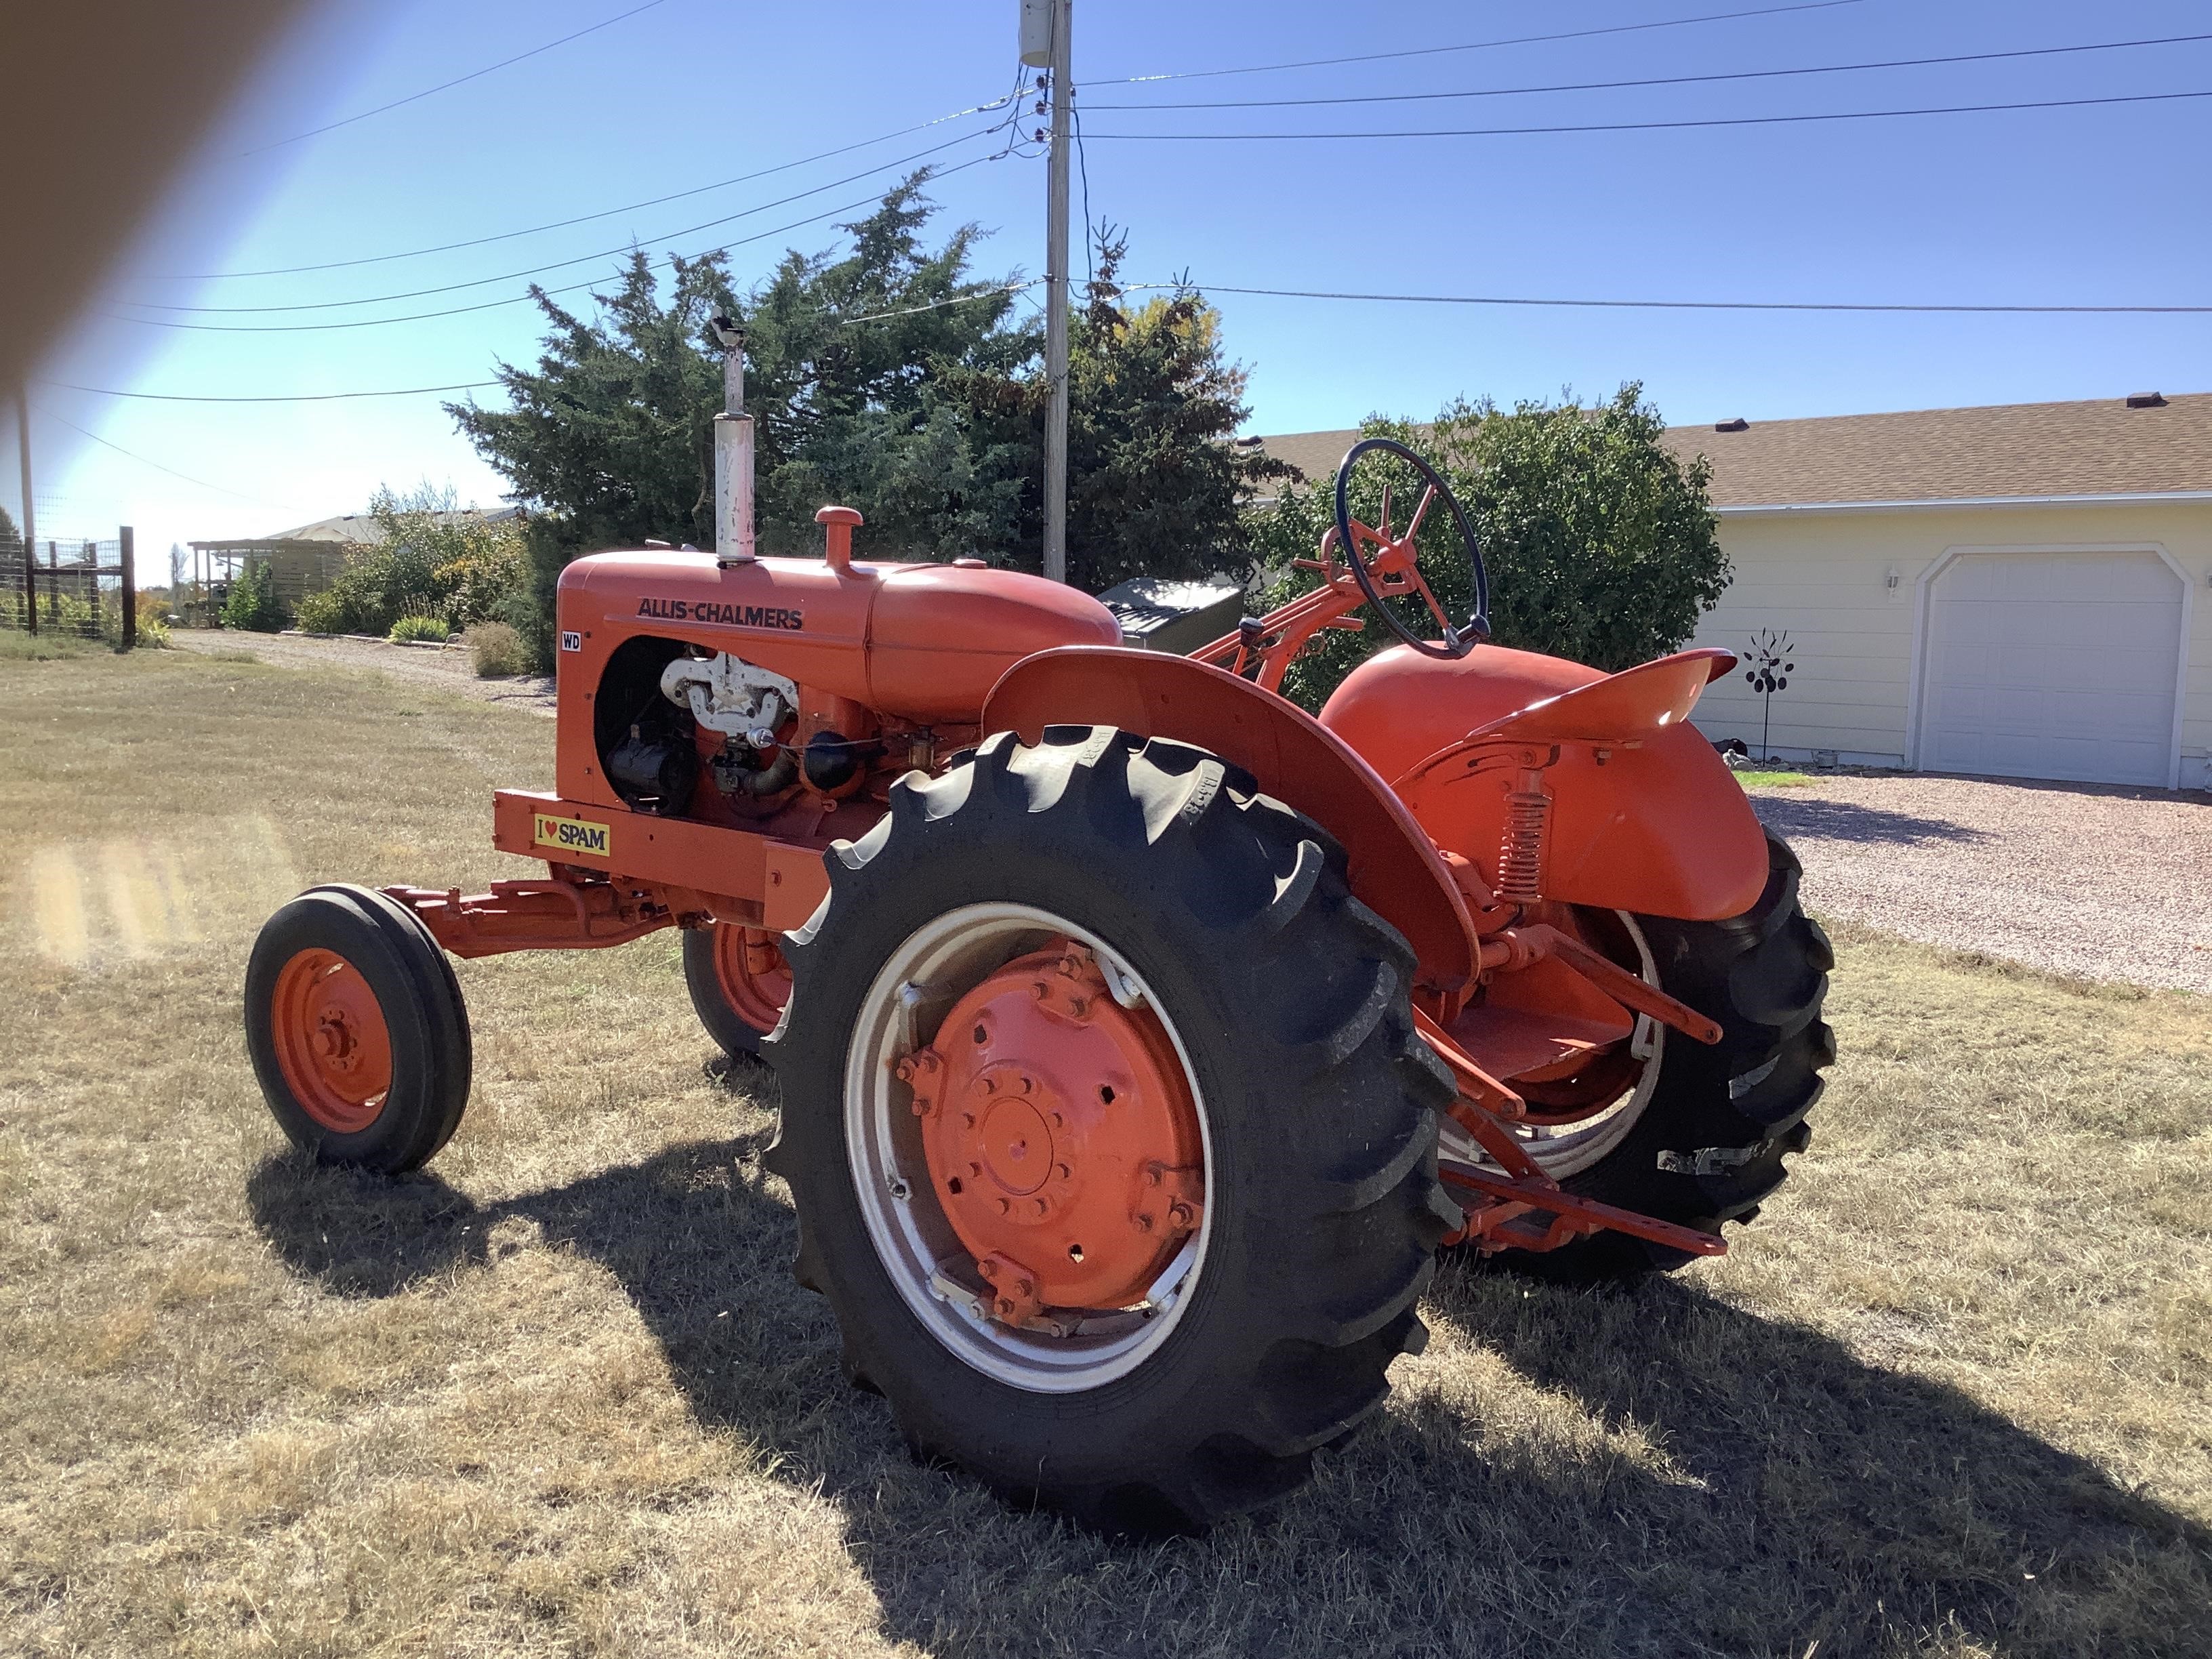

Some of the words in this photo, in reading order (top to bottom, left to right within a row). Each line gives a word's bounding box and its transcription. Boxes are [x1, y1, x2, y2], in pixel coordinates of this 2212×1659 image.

[637, 598, 803, 630] ALLIS-CHALMERS
[563, 634, 579, 649] WD
[538, 819, 544, 838] I
[559, 823, 605, 851] SPAM
